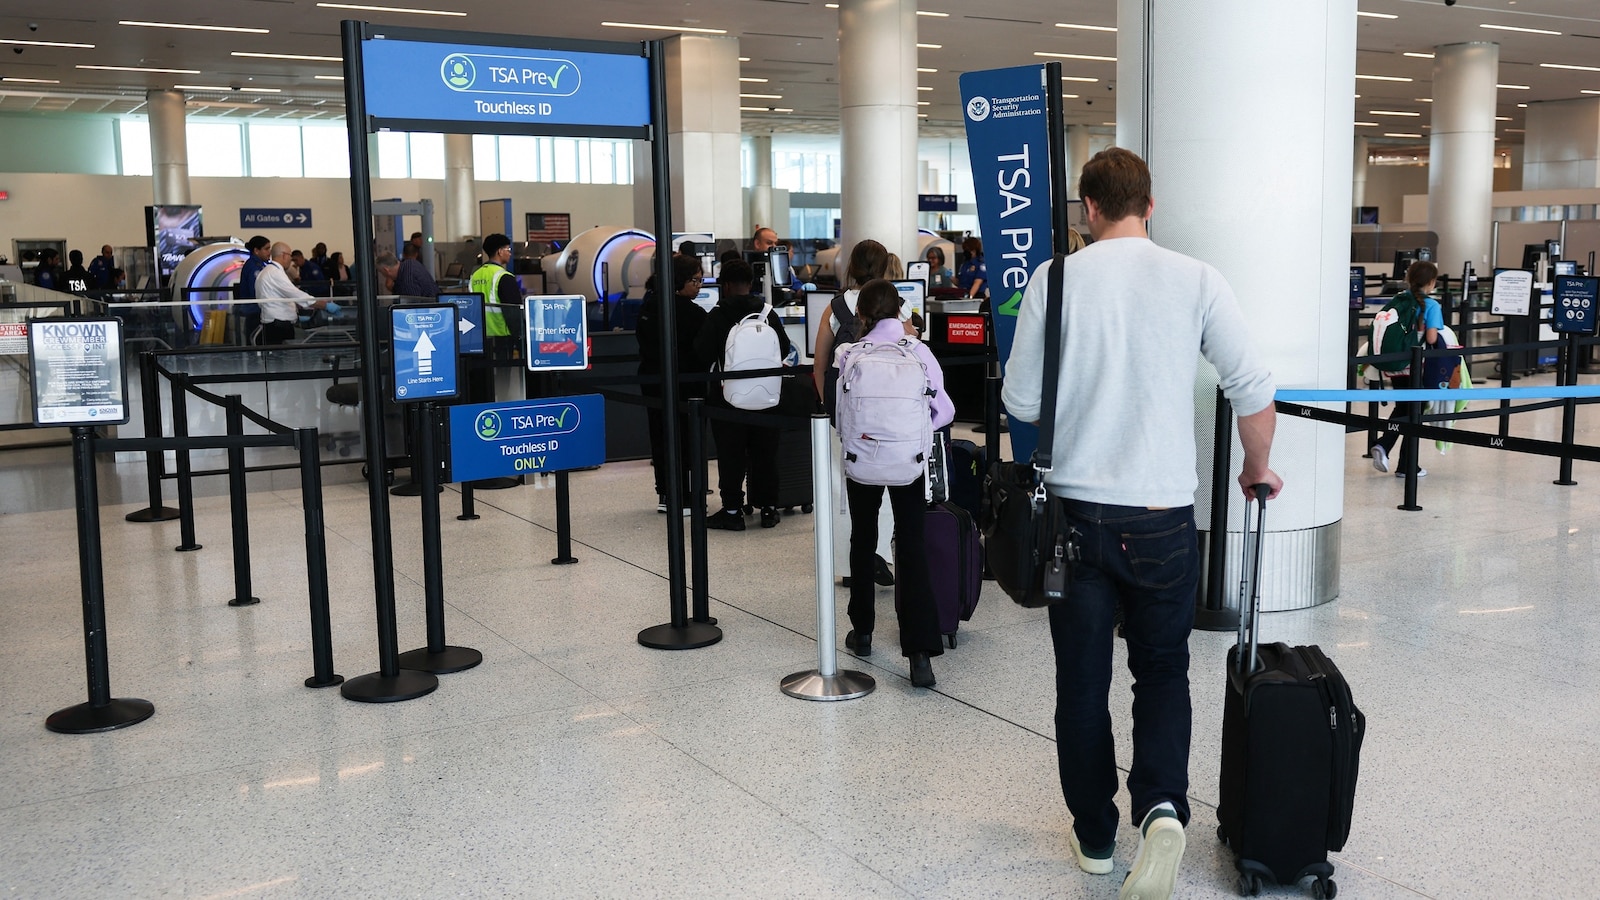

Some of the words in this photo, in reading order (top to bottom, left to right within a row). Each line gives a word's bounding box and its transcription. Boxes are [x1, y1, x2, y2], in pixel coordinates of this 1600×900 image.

[489, 66, 519, 84] TSA
[522, 68, 547, 85] Pre
[992, 94, 1040, 104] Transportation
[474, 100, 536, 114] Touchless
[538, 102, 552, 116] ID
[992, 104, 1020, 112] Security
[992, 108, 1041, 118] Administration
[997, 143, 1032, 219] TSA
[1001, 228, 1033, 288] Pre
[69, 279, 87, 291] TSA
[42, 324, 106, 338] KNOWN
[1301, 408, 1312, 417] LAX
[511, 416, 534, 430] TSA
[536, 414, 555, 427] Pre
[1388, 422, 1400, 432] LAX
[500, 442, 546, 456] Touchless
[548, 440, 558, 451] ID
[1490, 437, 1504, 447] LAX
[514, 456, 546, 471] ONLY
